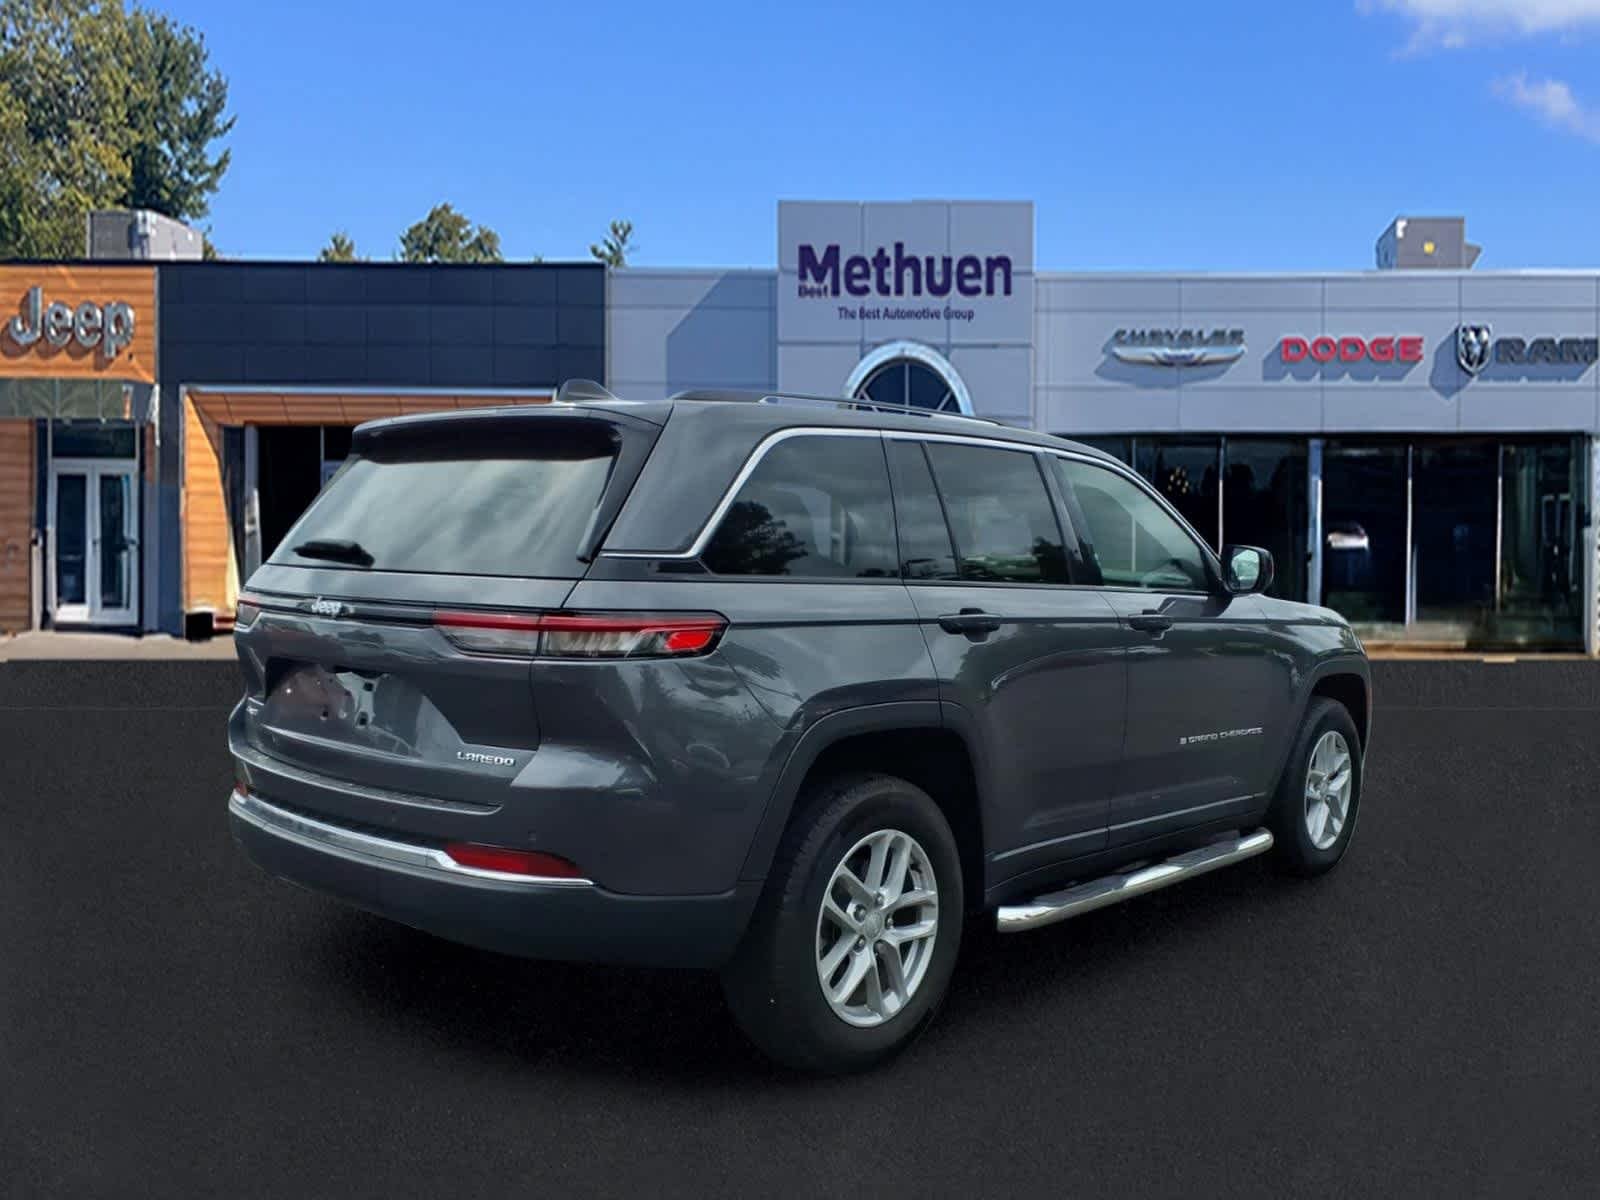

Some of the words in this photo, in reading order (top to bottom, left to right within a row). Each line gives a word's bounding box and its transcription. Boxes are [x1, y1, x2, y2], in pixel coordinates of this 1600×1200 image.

[798, 241, 1012, 297] Methuen
[798, 282, 828, 298] Best
[9, 286, 135, 358] Jeep
[838, 306, 857, 320] The
[859, 306, 880, 320] Best
[883, 306, 941, 321] Automotive
[943, 306, 974, 321] Group
[1113, 329, 1245, 345] CHRYSLER
[1280, 336, 1425, 363] DODGE
[1497, 338, 1598, 364] RAM
[311, 597, 342, 616] Jeep
[457, 750, 516, 766] LAREDO
